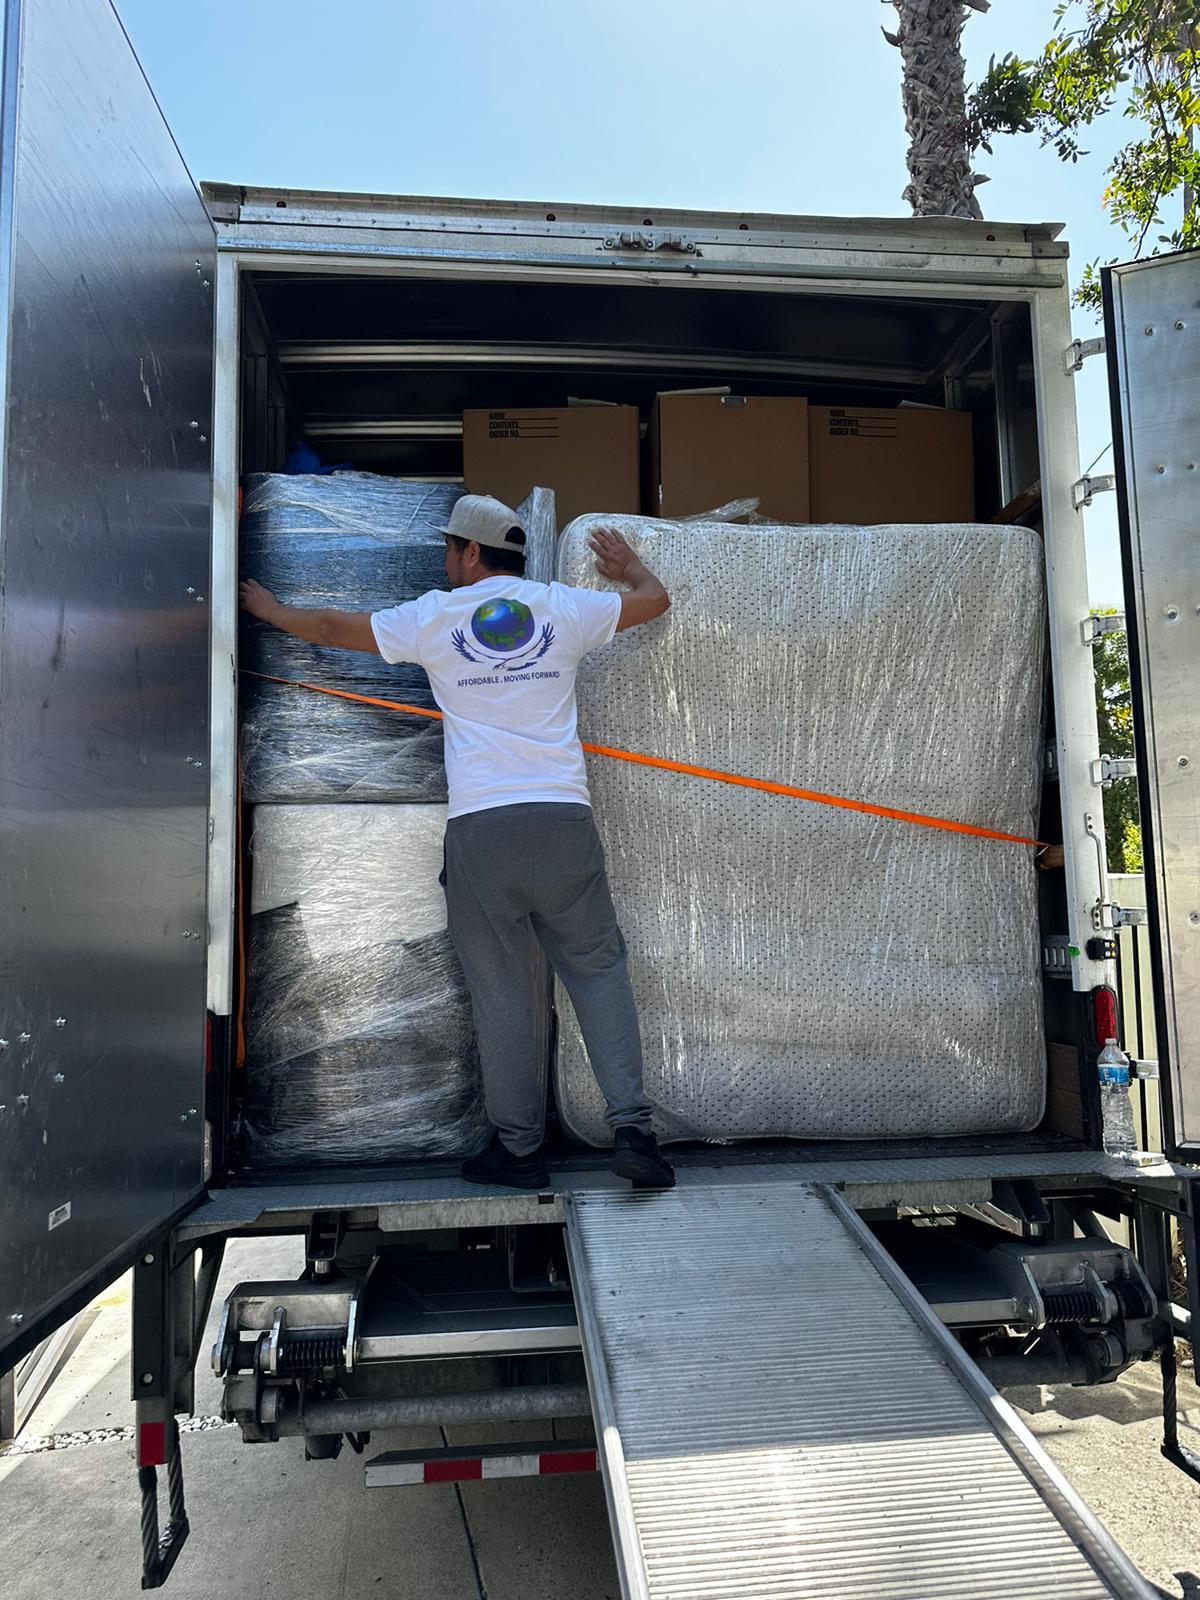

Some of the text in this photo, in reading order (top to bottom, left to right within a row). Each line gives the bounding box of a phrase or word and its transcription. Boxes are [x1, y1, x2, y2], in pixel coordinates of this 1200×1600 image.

[488, 421, 519, 429] CONTENTS
[829, 418, 859, 427] CONTENTS
[488, 430, 509, 439] ORDER
[829, 427, 849, 436] ORDER
[457, 676, 500, 687] AFFORDABLE
[503, 673, 531, 683] MOVING
[531, 671, 560, 680] FORWARD
